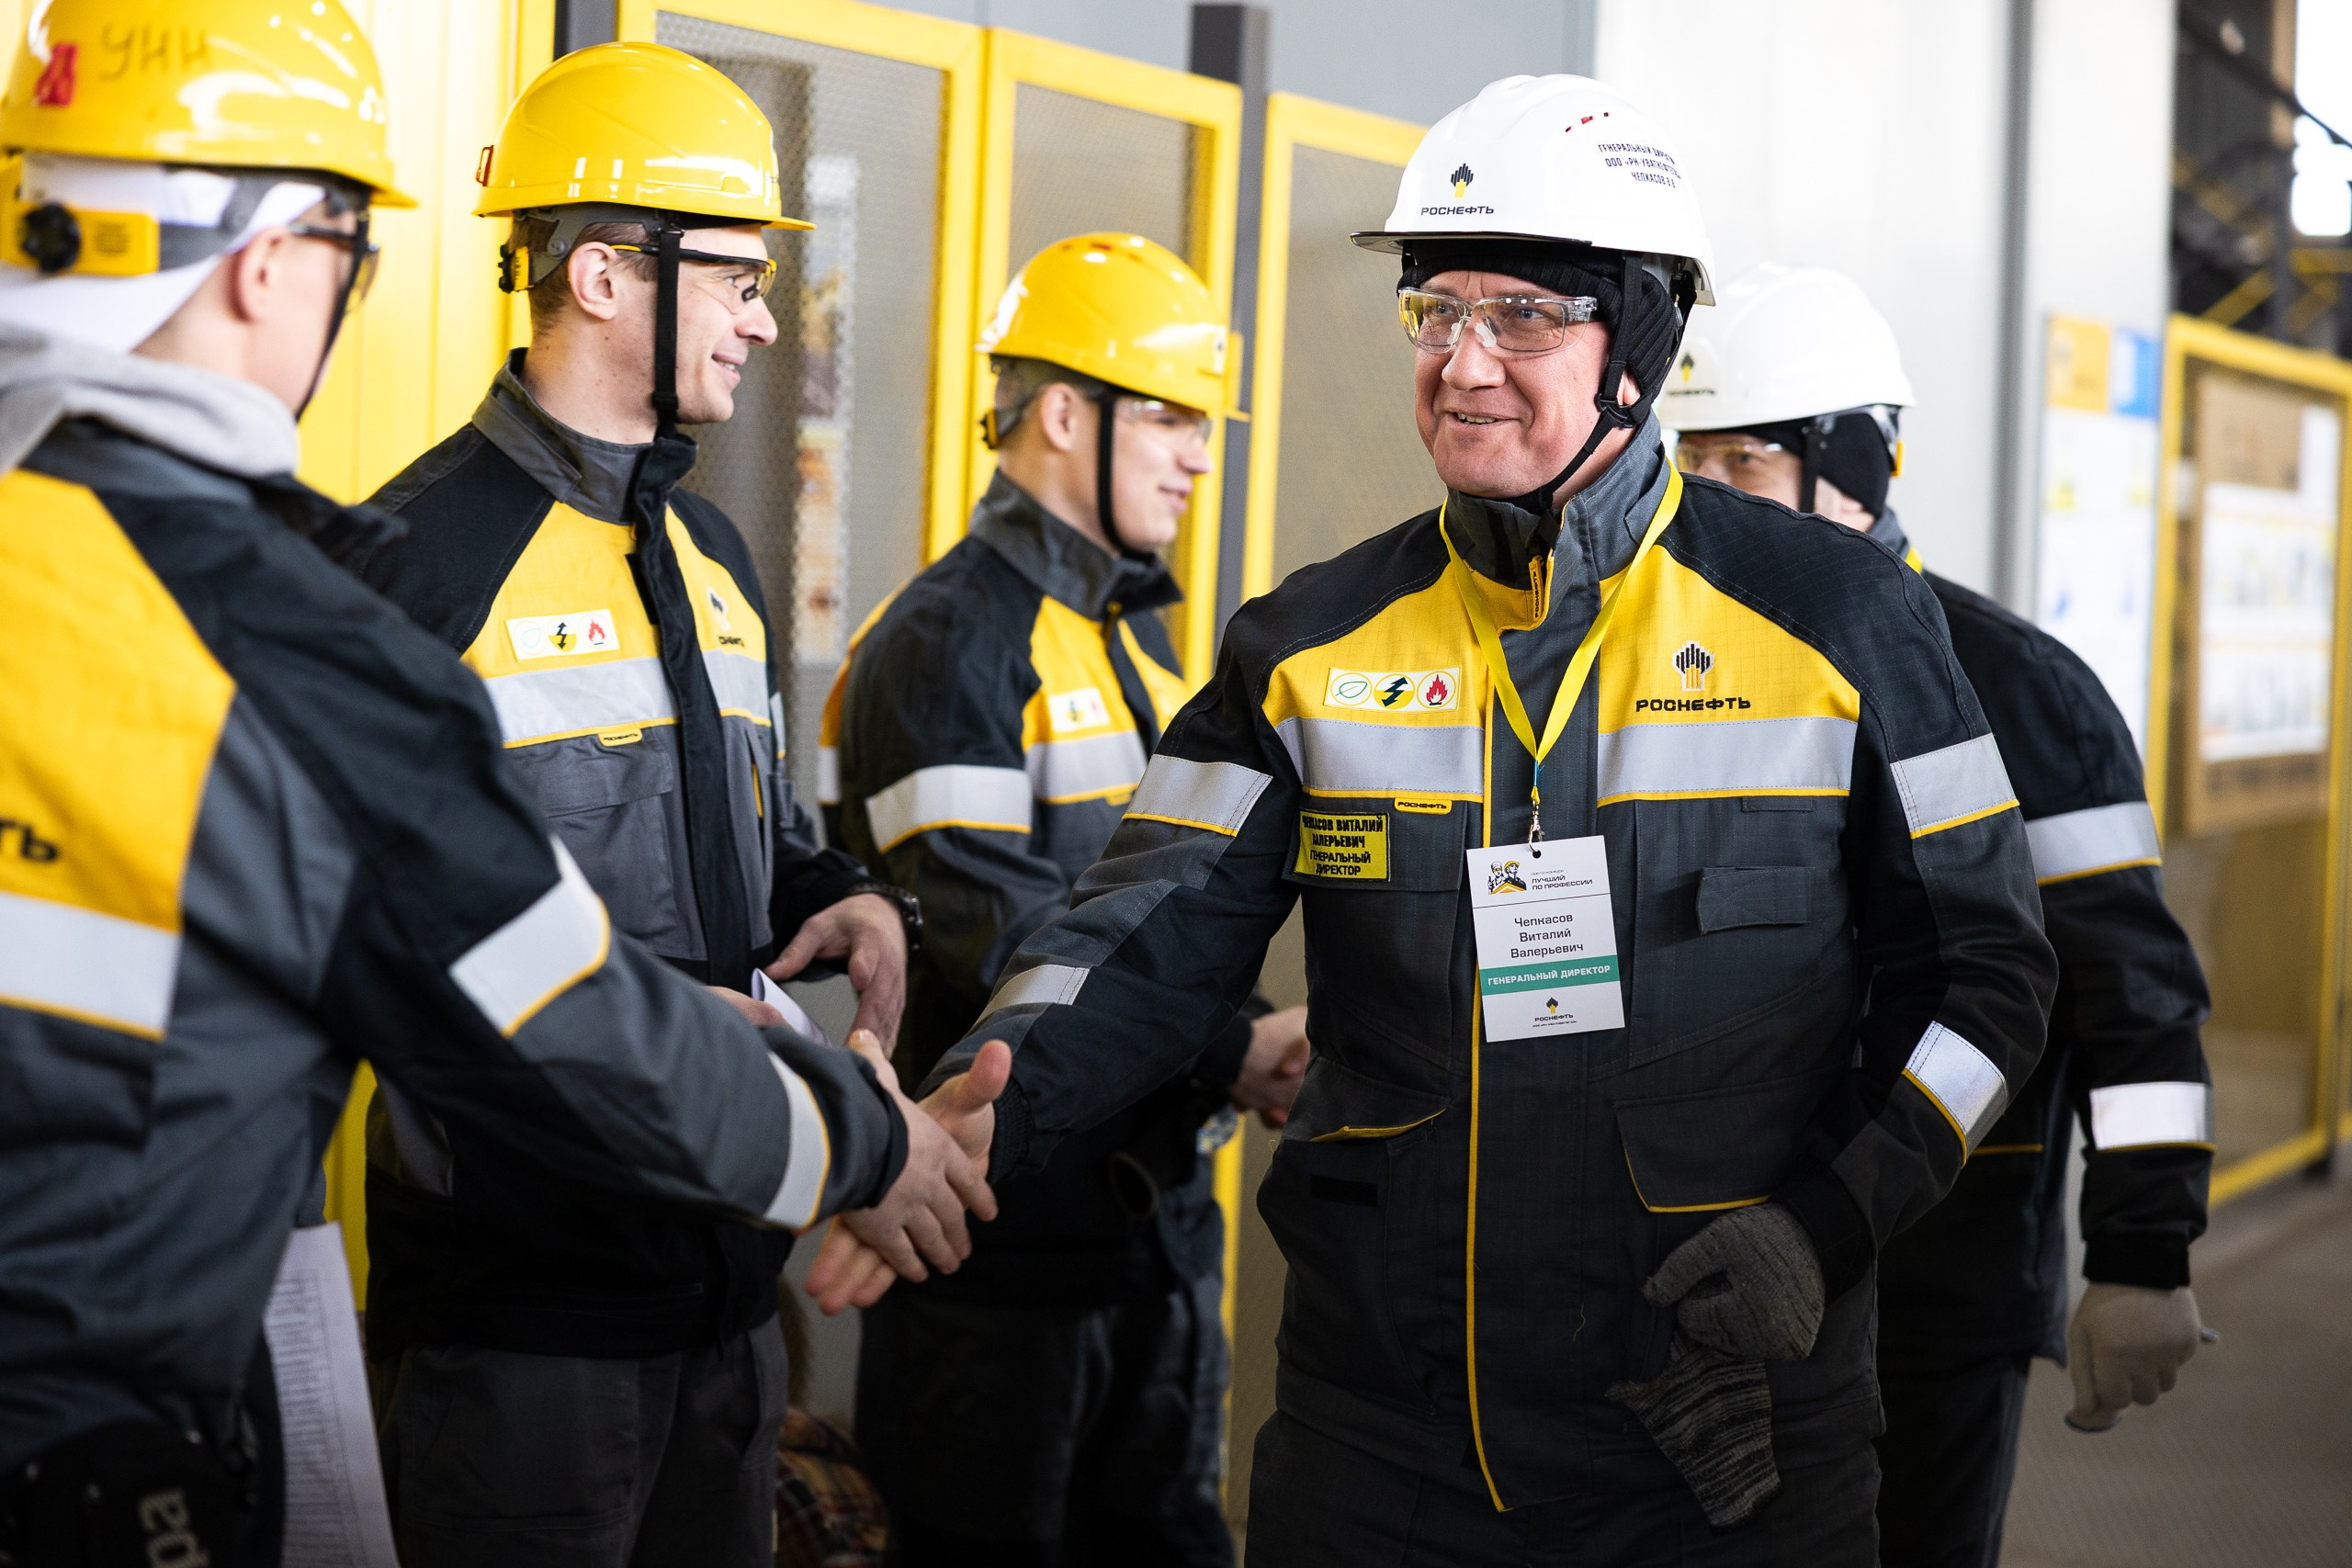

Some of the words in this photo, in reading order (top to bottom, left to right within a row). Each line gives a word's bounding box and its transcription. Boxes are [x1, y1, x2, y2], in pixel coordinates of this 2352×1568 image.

[1604, 157, 1623, 167] ООО
[1631, 171, 1666, 186] ЧЕПКАСОВ
[1420, 206, 1495, 216] РОСНЕФТЬ
[1635, 696, 1752, 713] РОСНЕФТЬ
[1397, 801, 1447, 810] РОСНЕФТЬ
[1302, 815, 1334, 831] ЧЕПАСОВ
[1336, 815, 1384, 833] ВИТАЛИЙ
[1315, 863, 1362, 876] ДИРЕКТОР
[1532, 874, 1566, 885] ЛУЧШИЙ
[1544, 879, 1593, 889] ПРОФЕССИИ
[1514, 914, 1573, 928] Чепкасов
[1520, 928, 1572, 942] Виталий
[1510, 943, 1584, 958] Валерьевич
[1487, 970, 1558, 986] ГЕНЕРАЛЬНЫЙ
[1560, 964, 1611, 979] ДИРЕКТОР
[1534, 1013, 1574, 1022] РОСНЕФТЬ
